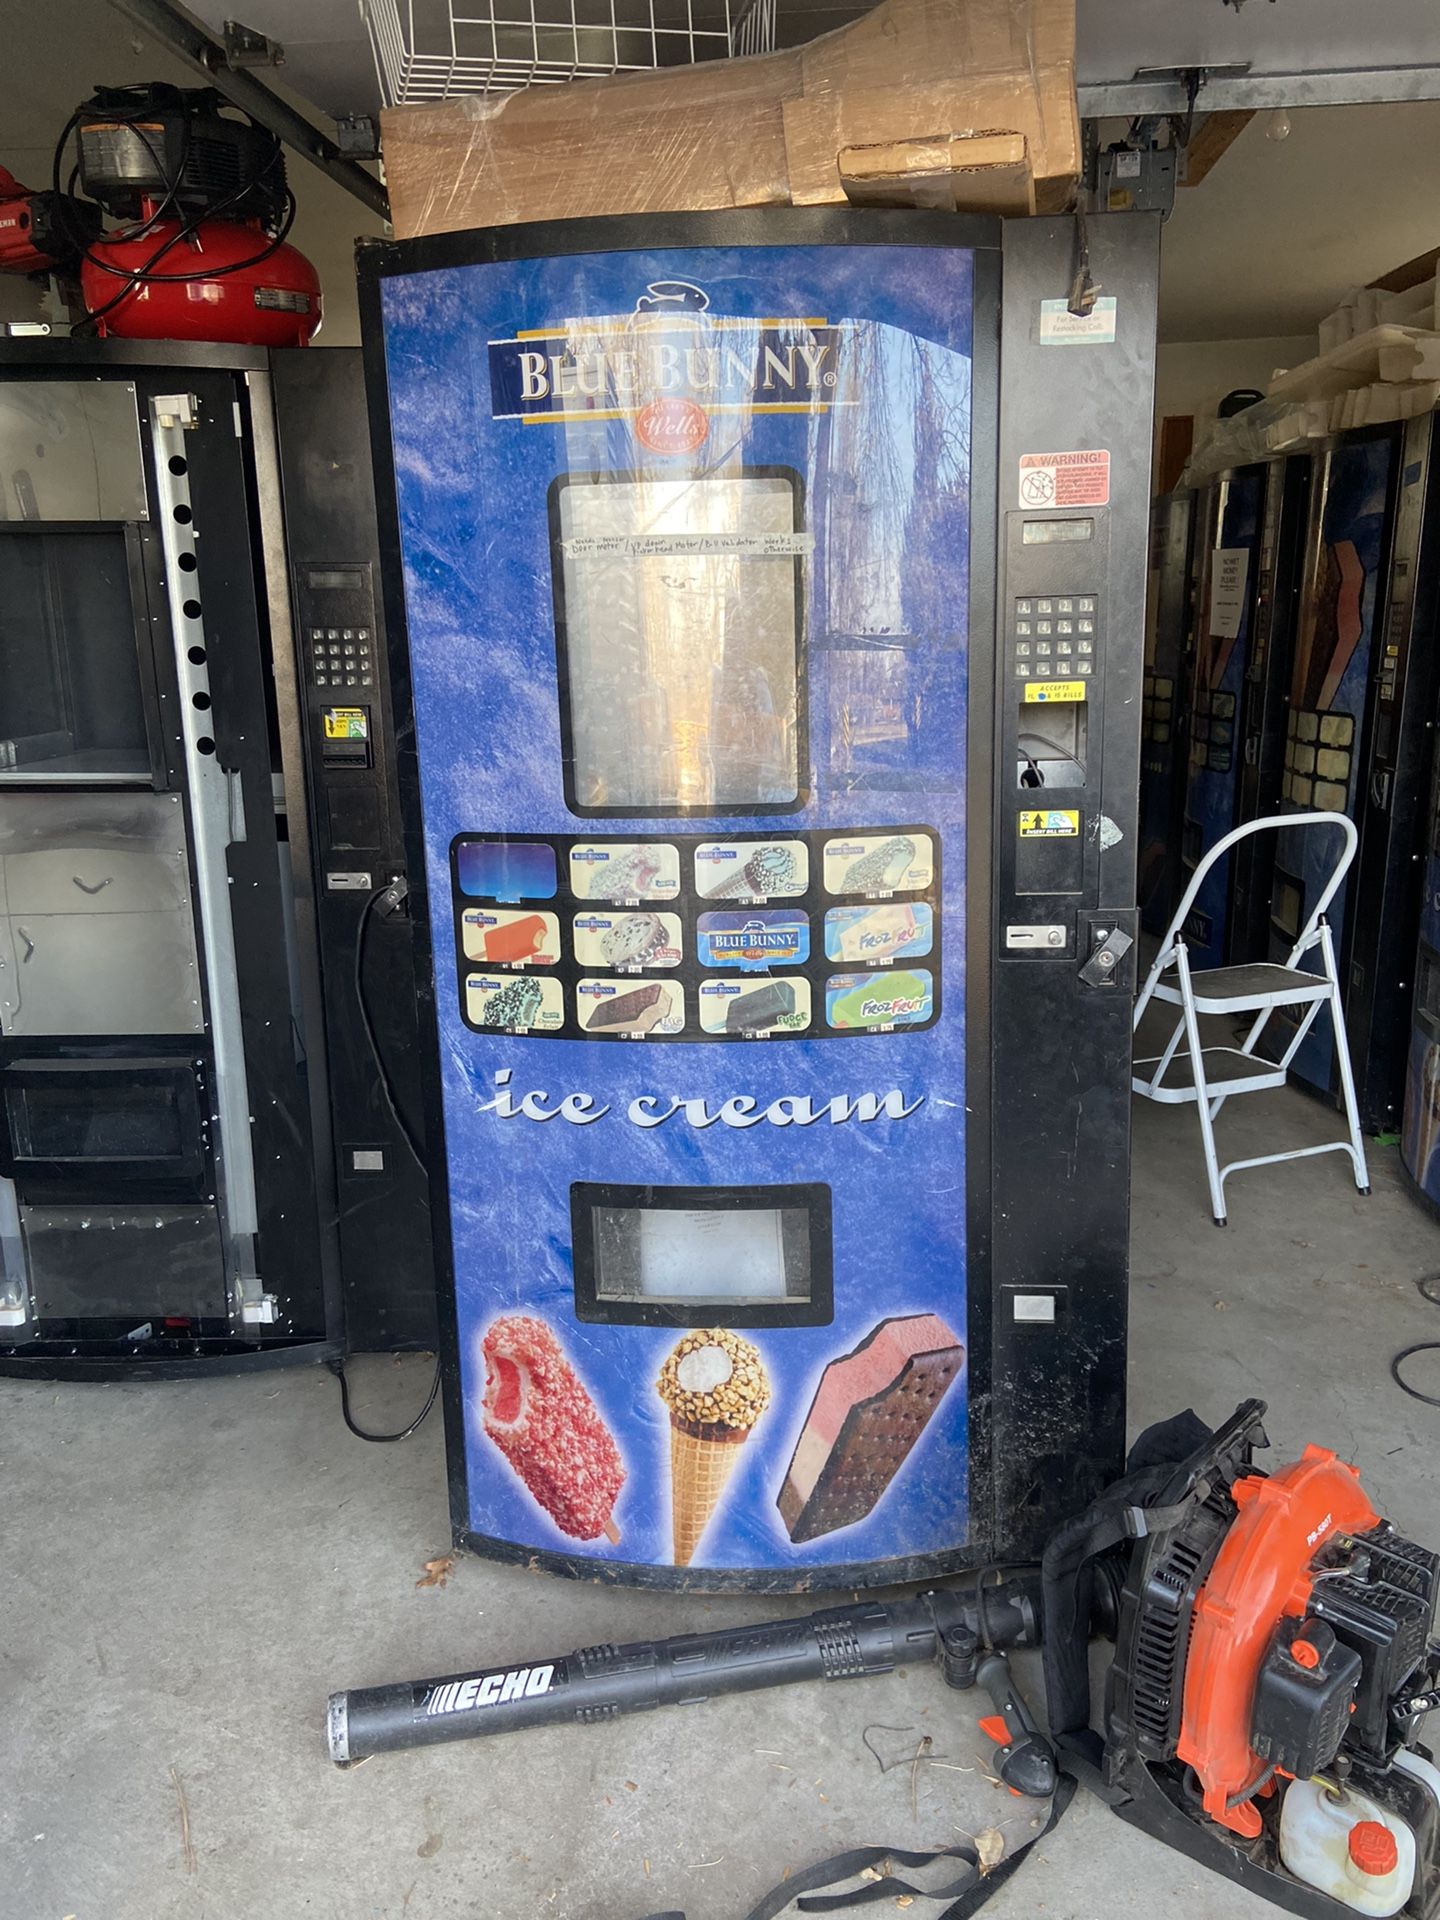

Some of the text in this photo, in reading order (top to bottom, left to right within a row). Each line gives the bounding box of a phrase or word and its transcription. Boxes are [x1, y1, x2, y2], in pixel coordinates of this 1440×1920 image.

[518, 351, 640, 400] BLUE
[643, 415, 699, 436] Wells
[1039, 452, 1102, 466] WARNING!
[715, 934, 796, 947] BLUE BUNNY
[861, 997, 931, 1016] FROZFRUIT
[777, 1012, 808, 1025] FUDGE
[481, 1068, 925, 1128] ice cream
[450, 1664, 555, 1712] ECHO
